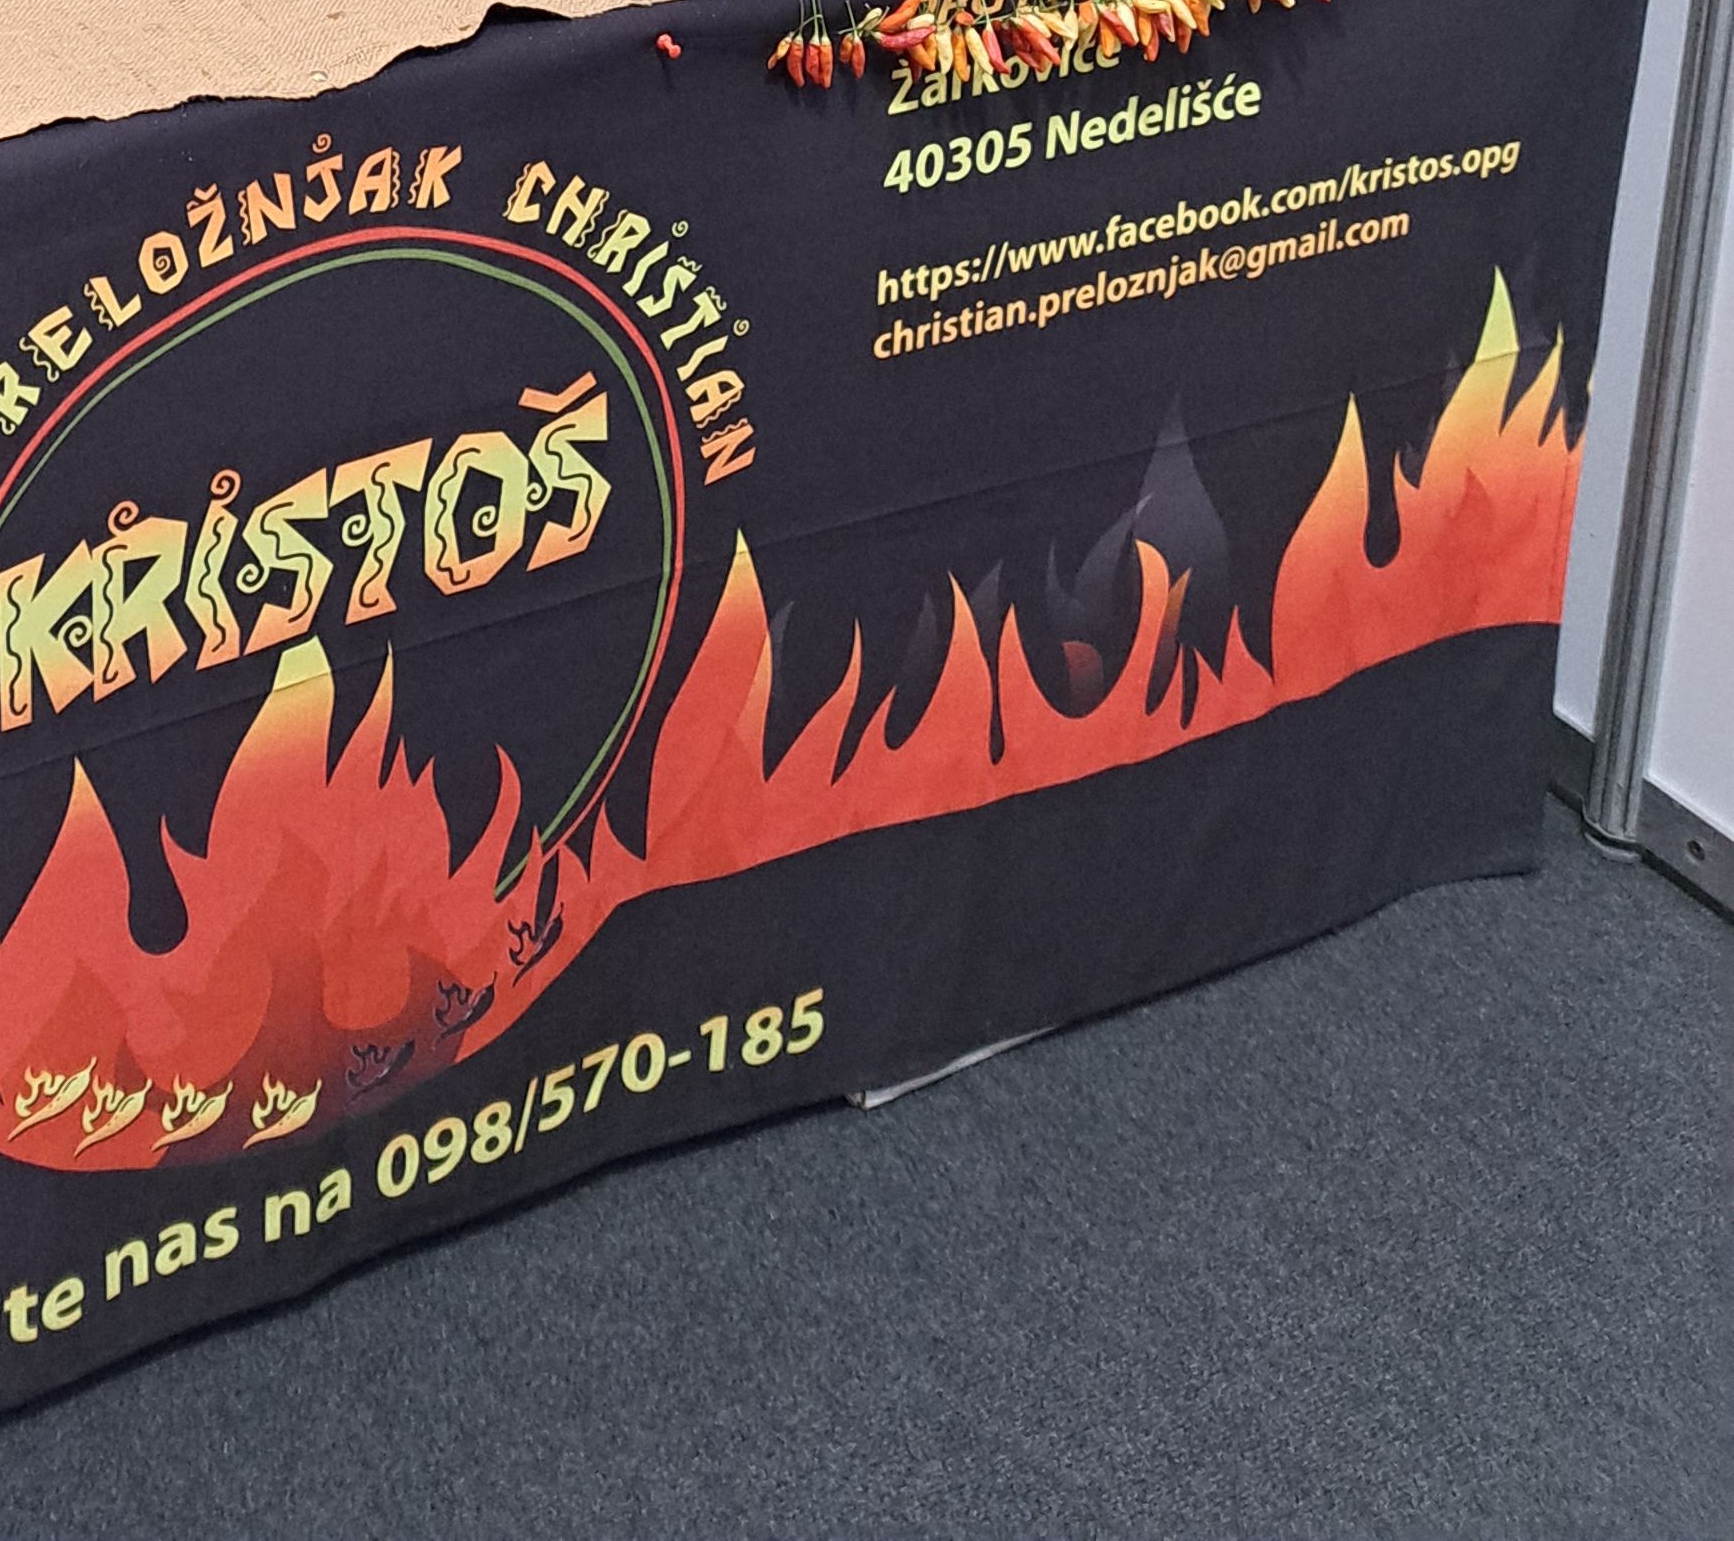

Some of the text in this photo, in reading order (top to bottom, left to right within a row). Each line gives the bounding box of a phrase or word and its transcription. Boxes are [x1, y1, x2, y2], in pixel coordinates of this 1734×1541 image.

[882, 72, 1263, 194] 40305 Nedelišće
[872, 212, 1410, 360] christian.preloznjak@gmail.com
[876, 140, 1521, 307] https://www.facebook.com/kristos.opg
[502, 160, 756, 485] CHRISTIAN
[103, 1196, 241, 1302] nas
[261, 1166, 354, 1243] na
[374, 988, 826, 1202] 098/570-185
